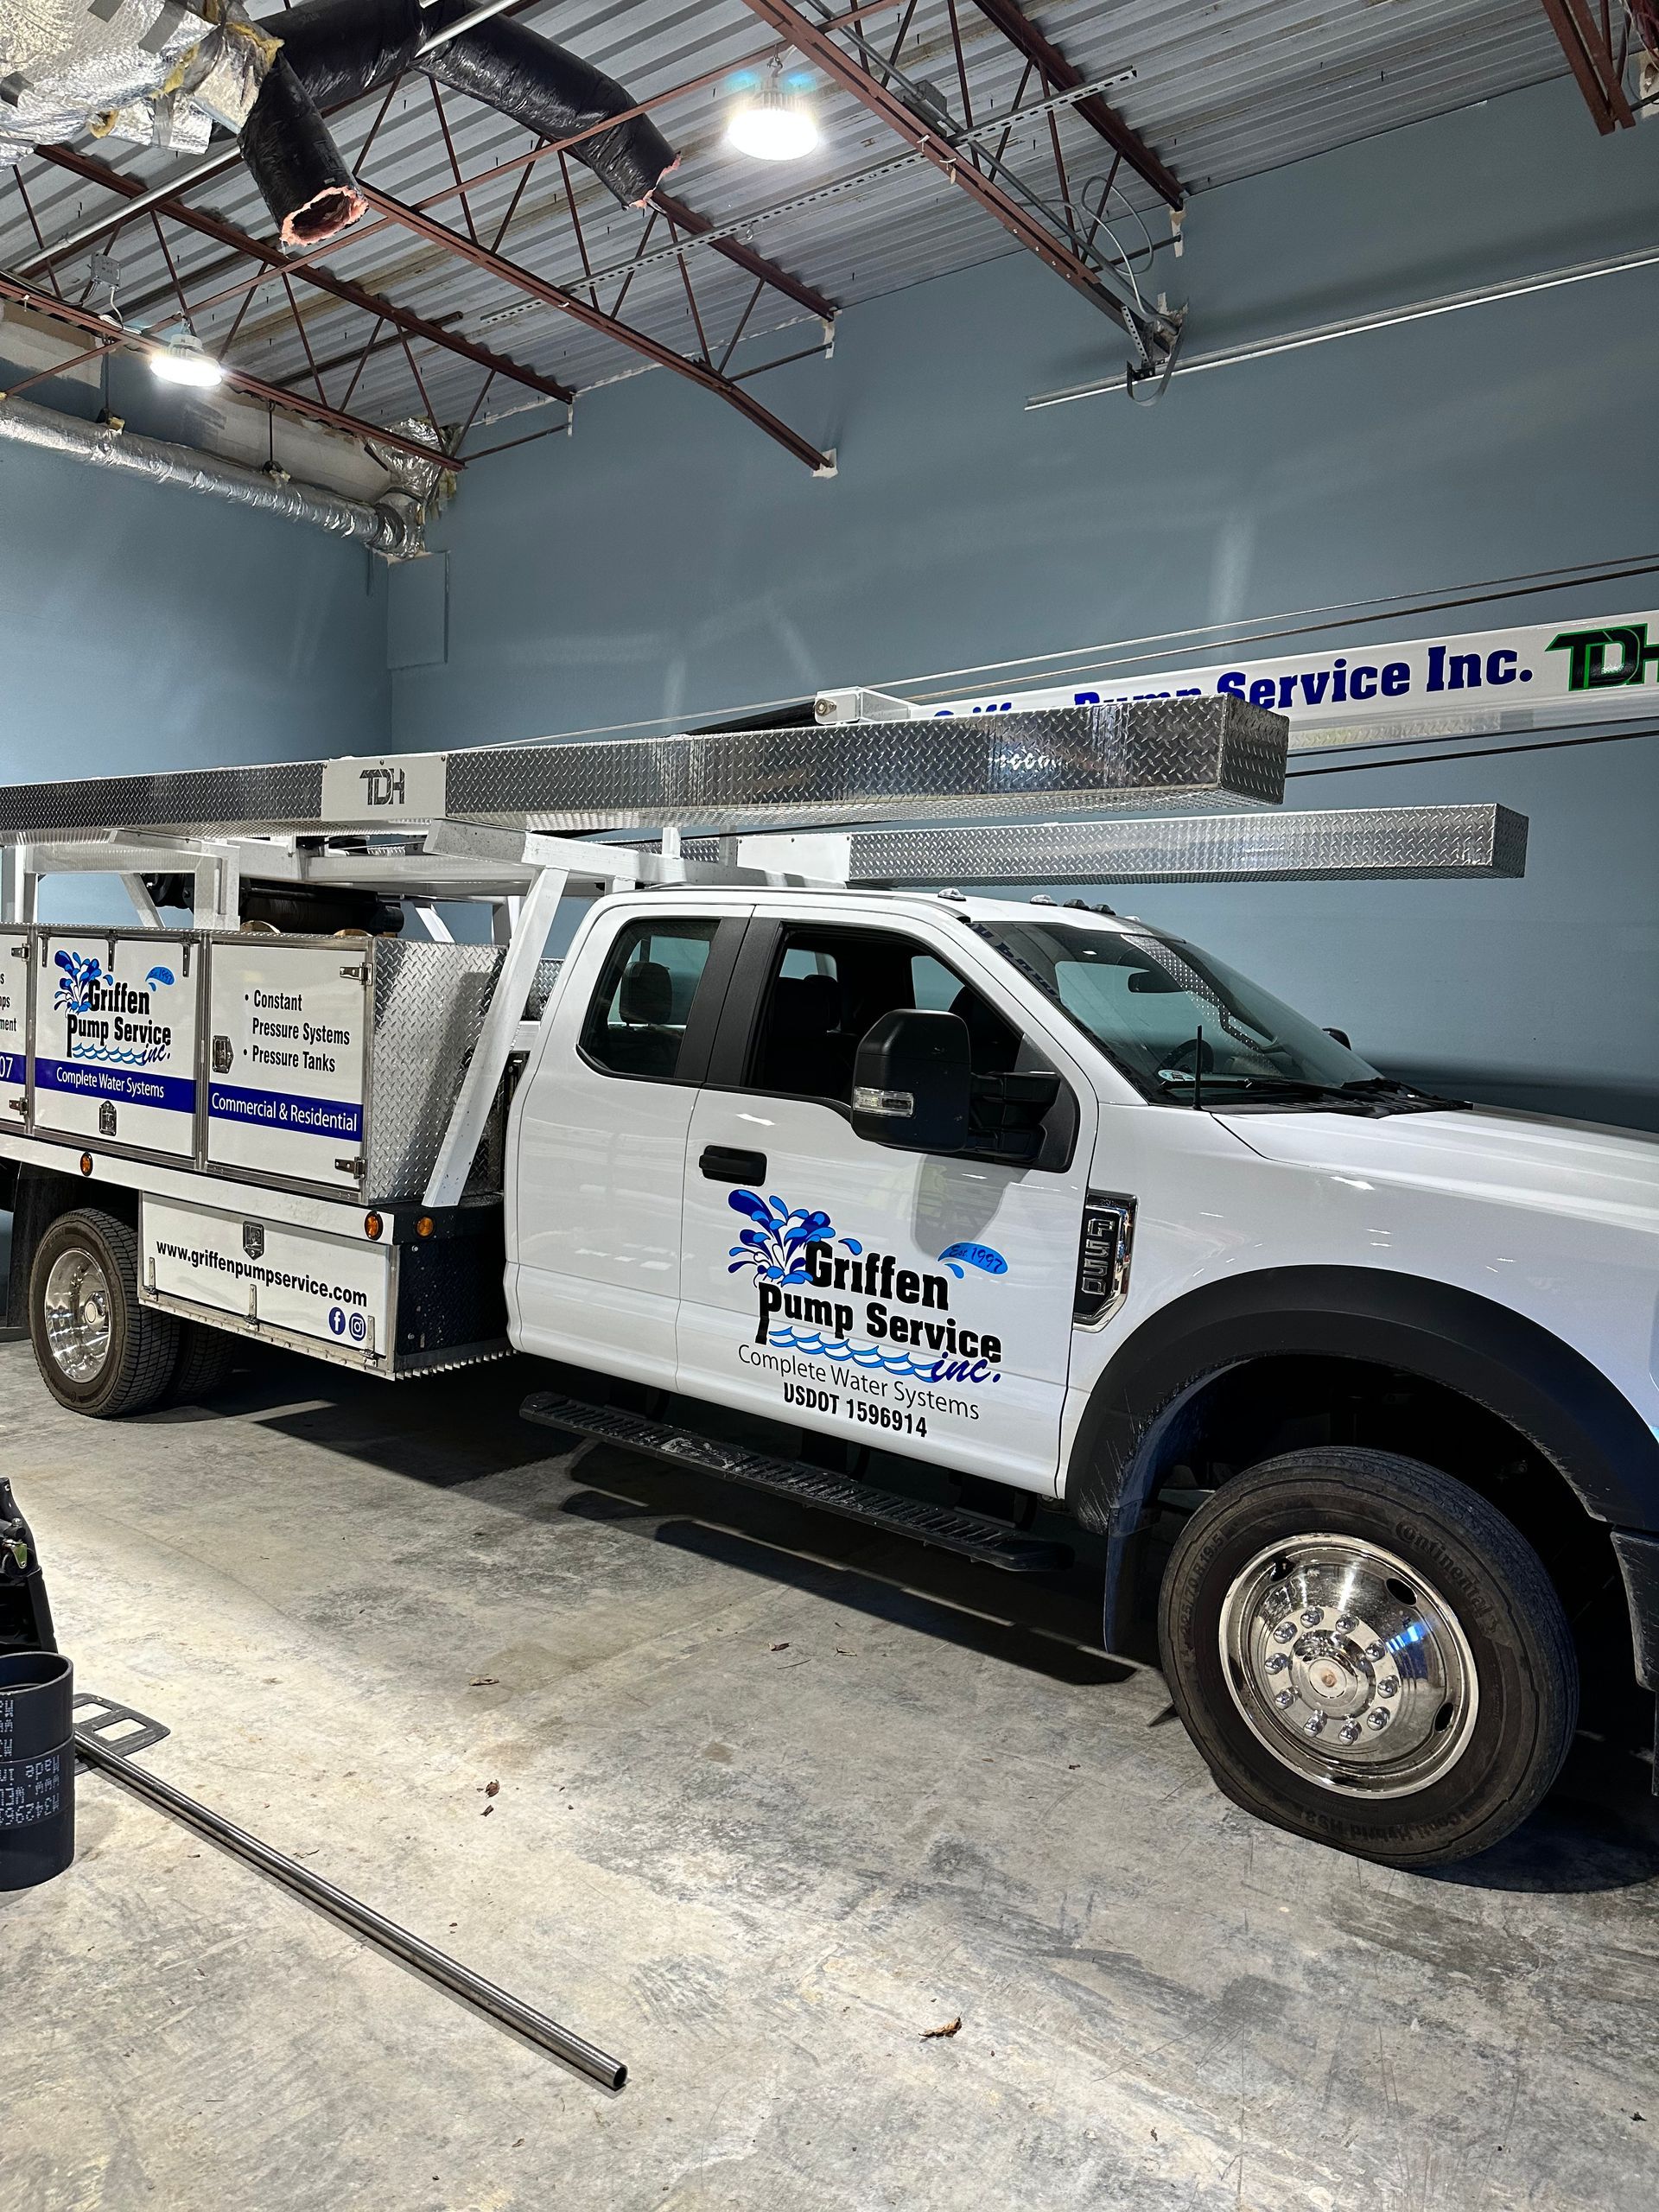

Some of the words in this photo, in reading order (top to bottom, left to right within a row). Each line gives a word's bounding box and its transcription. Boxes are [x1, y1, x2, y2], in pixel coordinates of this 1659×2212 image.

[1217, 658, 1410, 710] Service
[1427, 645, 1534, 692] Inc.
[359, 768, 405, 805] TDH
[88, 979, 150, 1015] Griffen
[254, 989, 302, 1012] Constant
[67, 1014, 109, 1058] Pump
[114, 1016, 171, 1046] Service
[252, 1017, 299, 1039] Pressure
[302, 1022, 350, 1046] Systems
[252, 1045, 299, 1068] Pressure
[302, 1051, 336, 1073] Tanks
[56, 1066, 98, 1089] Complete
[99, 1073, 125, 1092] Water
[127, 1077, 164, 1098] Systems
[212, 1092, 276, 1119] Commercial
[278, 1103, 288, 1121] &
[290, 1104, 357, 1132] Residential
[156, 1241, 367, 1307] www.griffenpumpservice.com
[805, 1238, 950, 1311] Griffen
[970, 1247, 1003, 1273] 1997
[1081, 1218, 1115, 1296] F550
[755, 1281, 853, 1345] Pump
[866, 1301, 1001, 1363] Service
[739, 1344, 826, 1385] Complete
[831, 1364, 889, 1397] Water
[893, 1381, 980, 1421] Systems
[930, 1351, 1001, 1382] inc.
[784, 1382, 839, 1414] USDOT
[846, 1400, 928, 1438] 1596914
[1395, 1521, 1493, 1619] Continental
